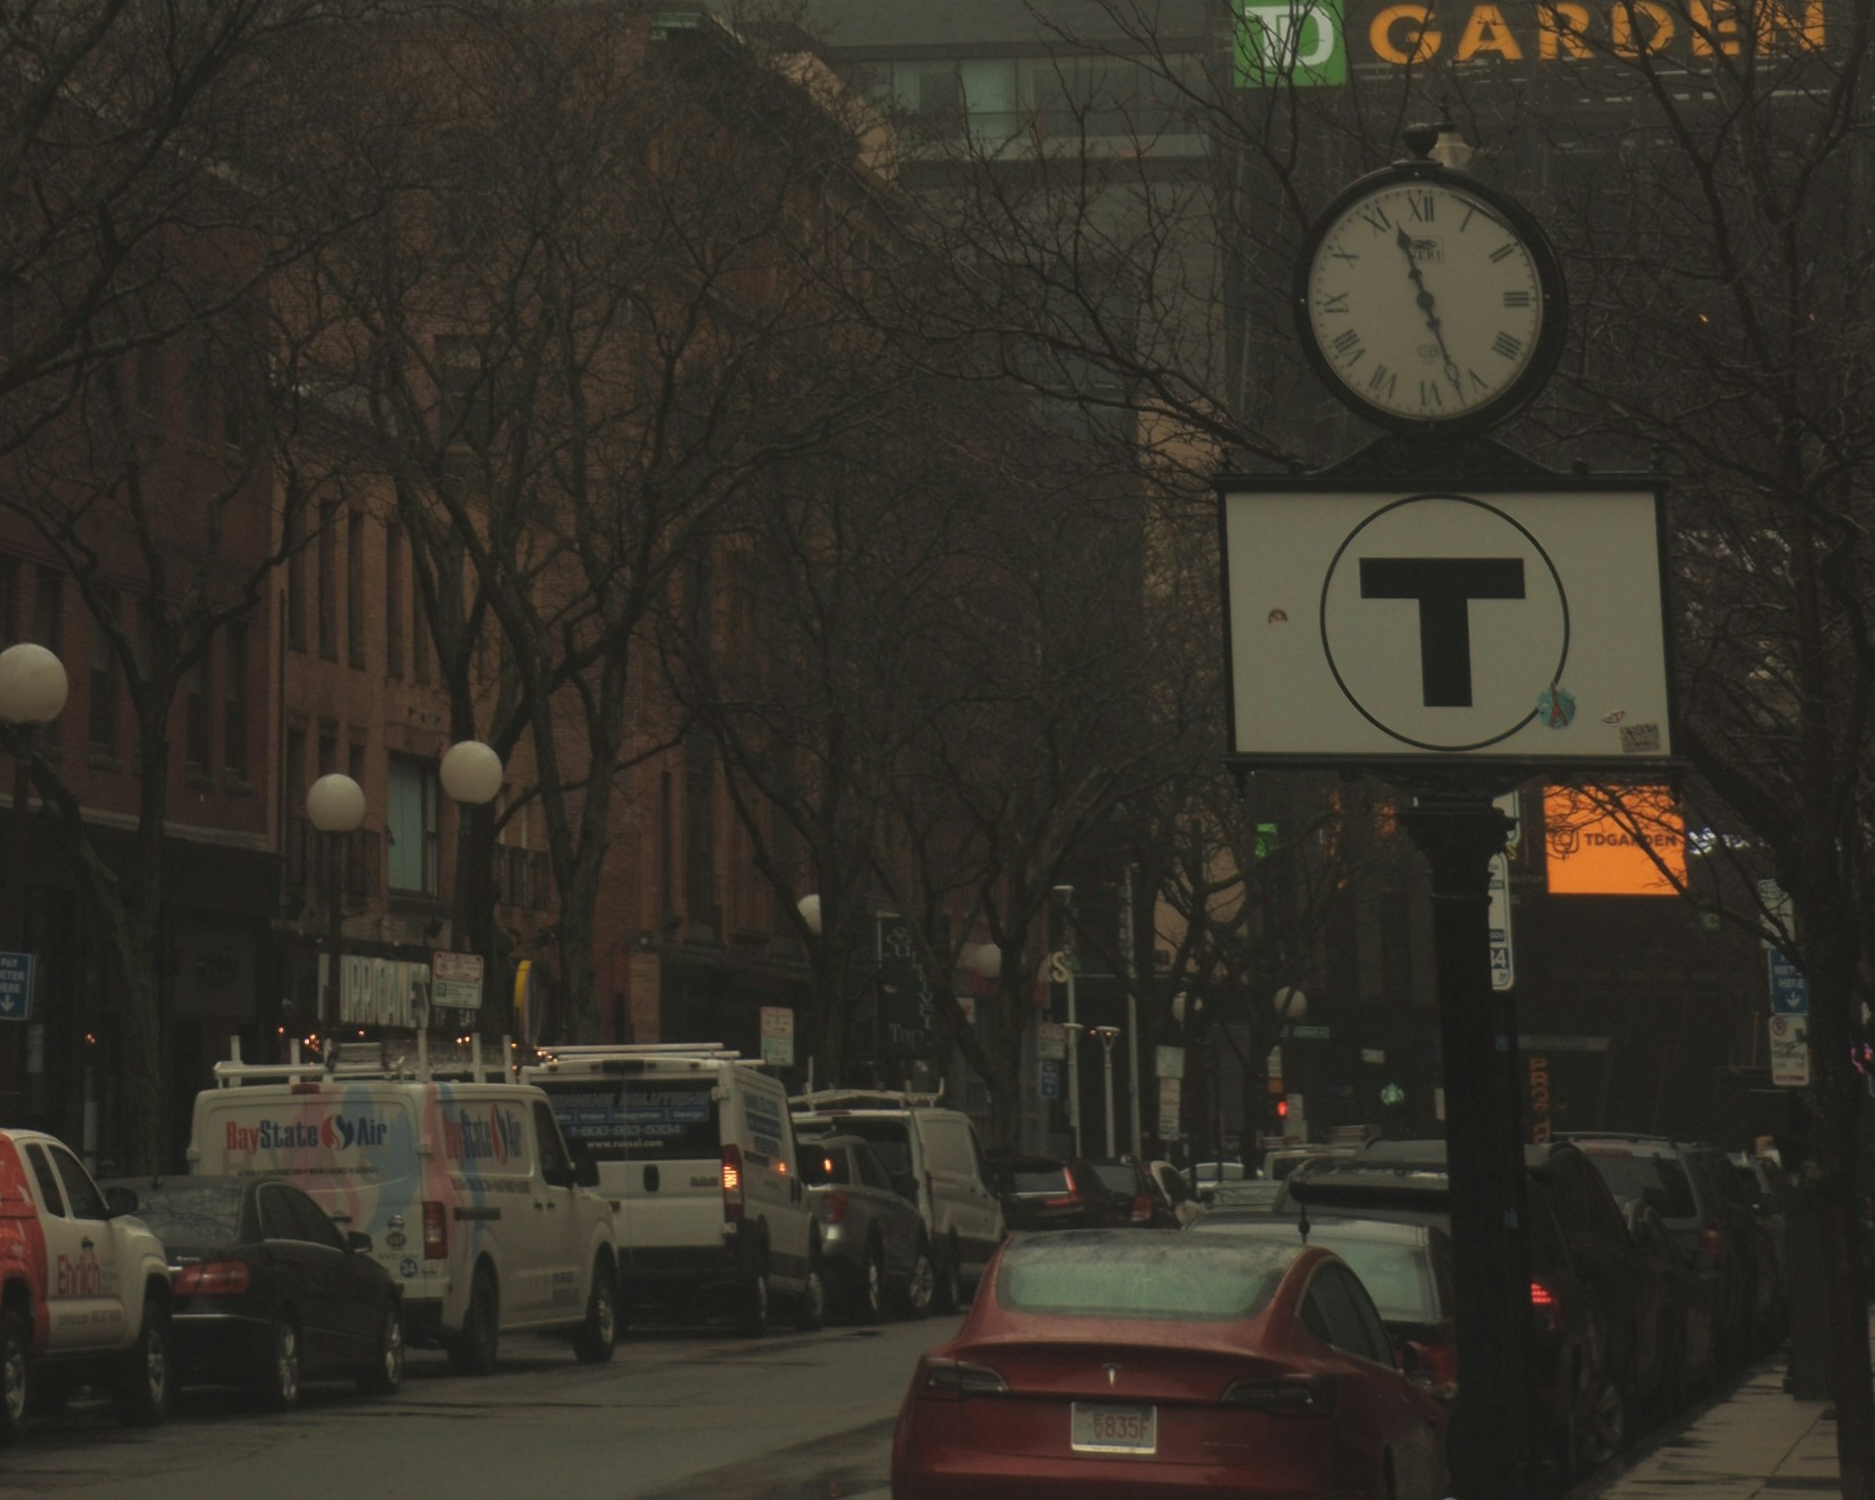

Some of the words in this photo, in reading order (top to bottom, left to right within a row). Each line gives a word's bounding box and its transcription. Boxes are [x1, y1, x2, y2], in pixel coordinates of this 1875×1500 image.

[1244, 4, 1335, 68] TD
[1359, 557, 1526, 708] T
[1584, 834, 1678, 847] TDGADEN
[0, 958, 18, 968] PAY
[226, 1120, 318, 1153] BayState
[357, 1118, 387, 1146] Air
